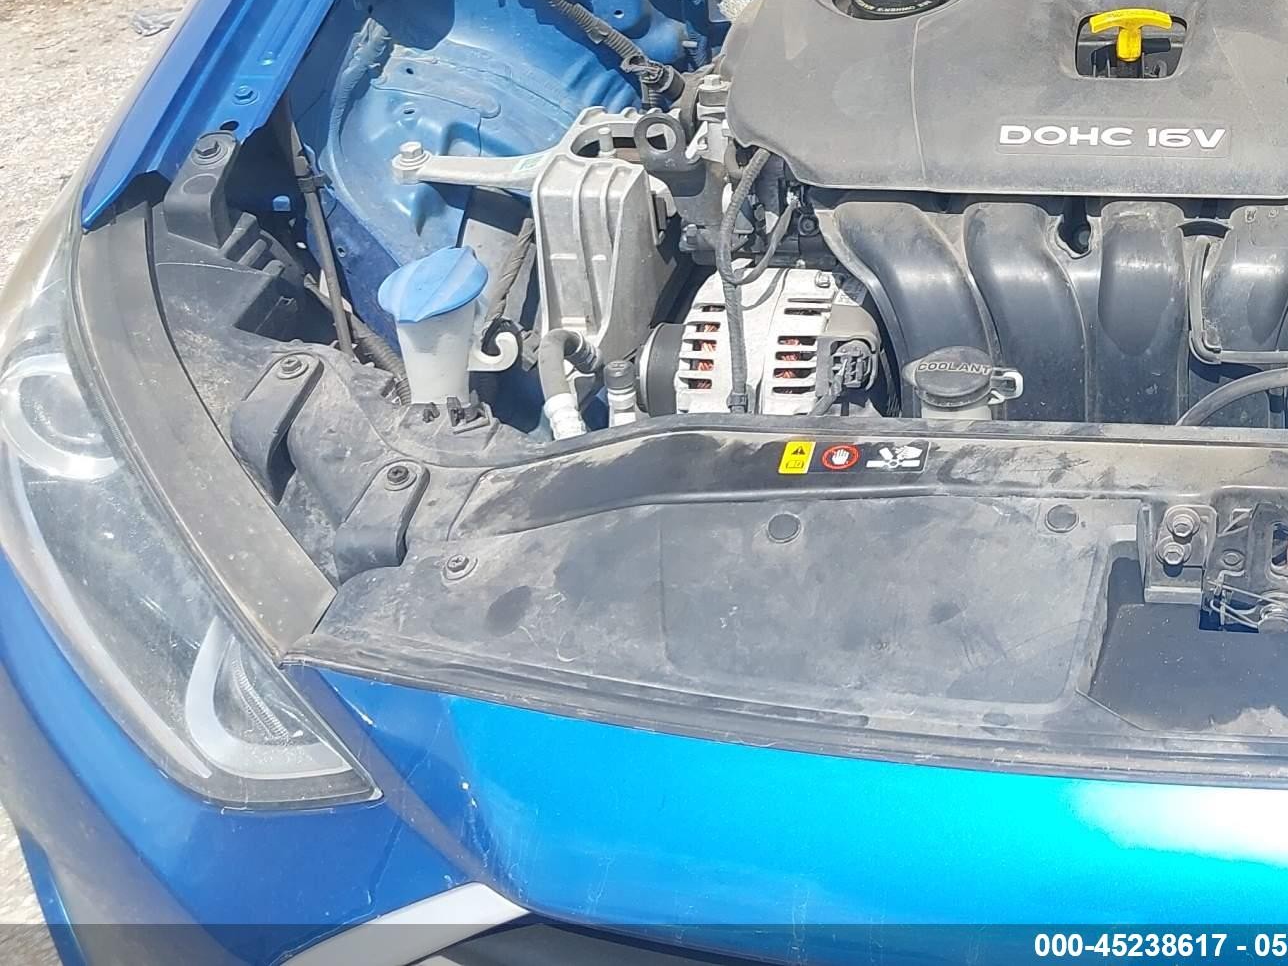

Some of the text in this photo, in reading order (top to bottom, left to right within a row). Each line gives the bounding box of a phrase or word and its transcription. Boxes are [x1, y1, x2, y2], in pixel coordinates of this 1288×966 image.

[999, 124, 1226, 149] DOHC 16V
[917, 362, 992, 376] COOLANT
